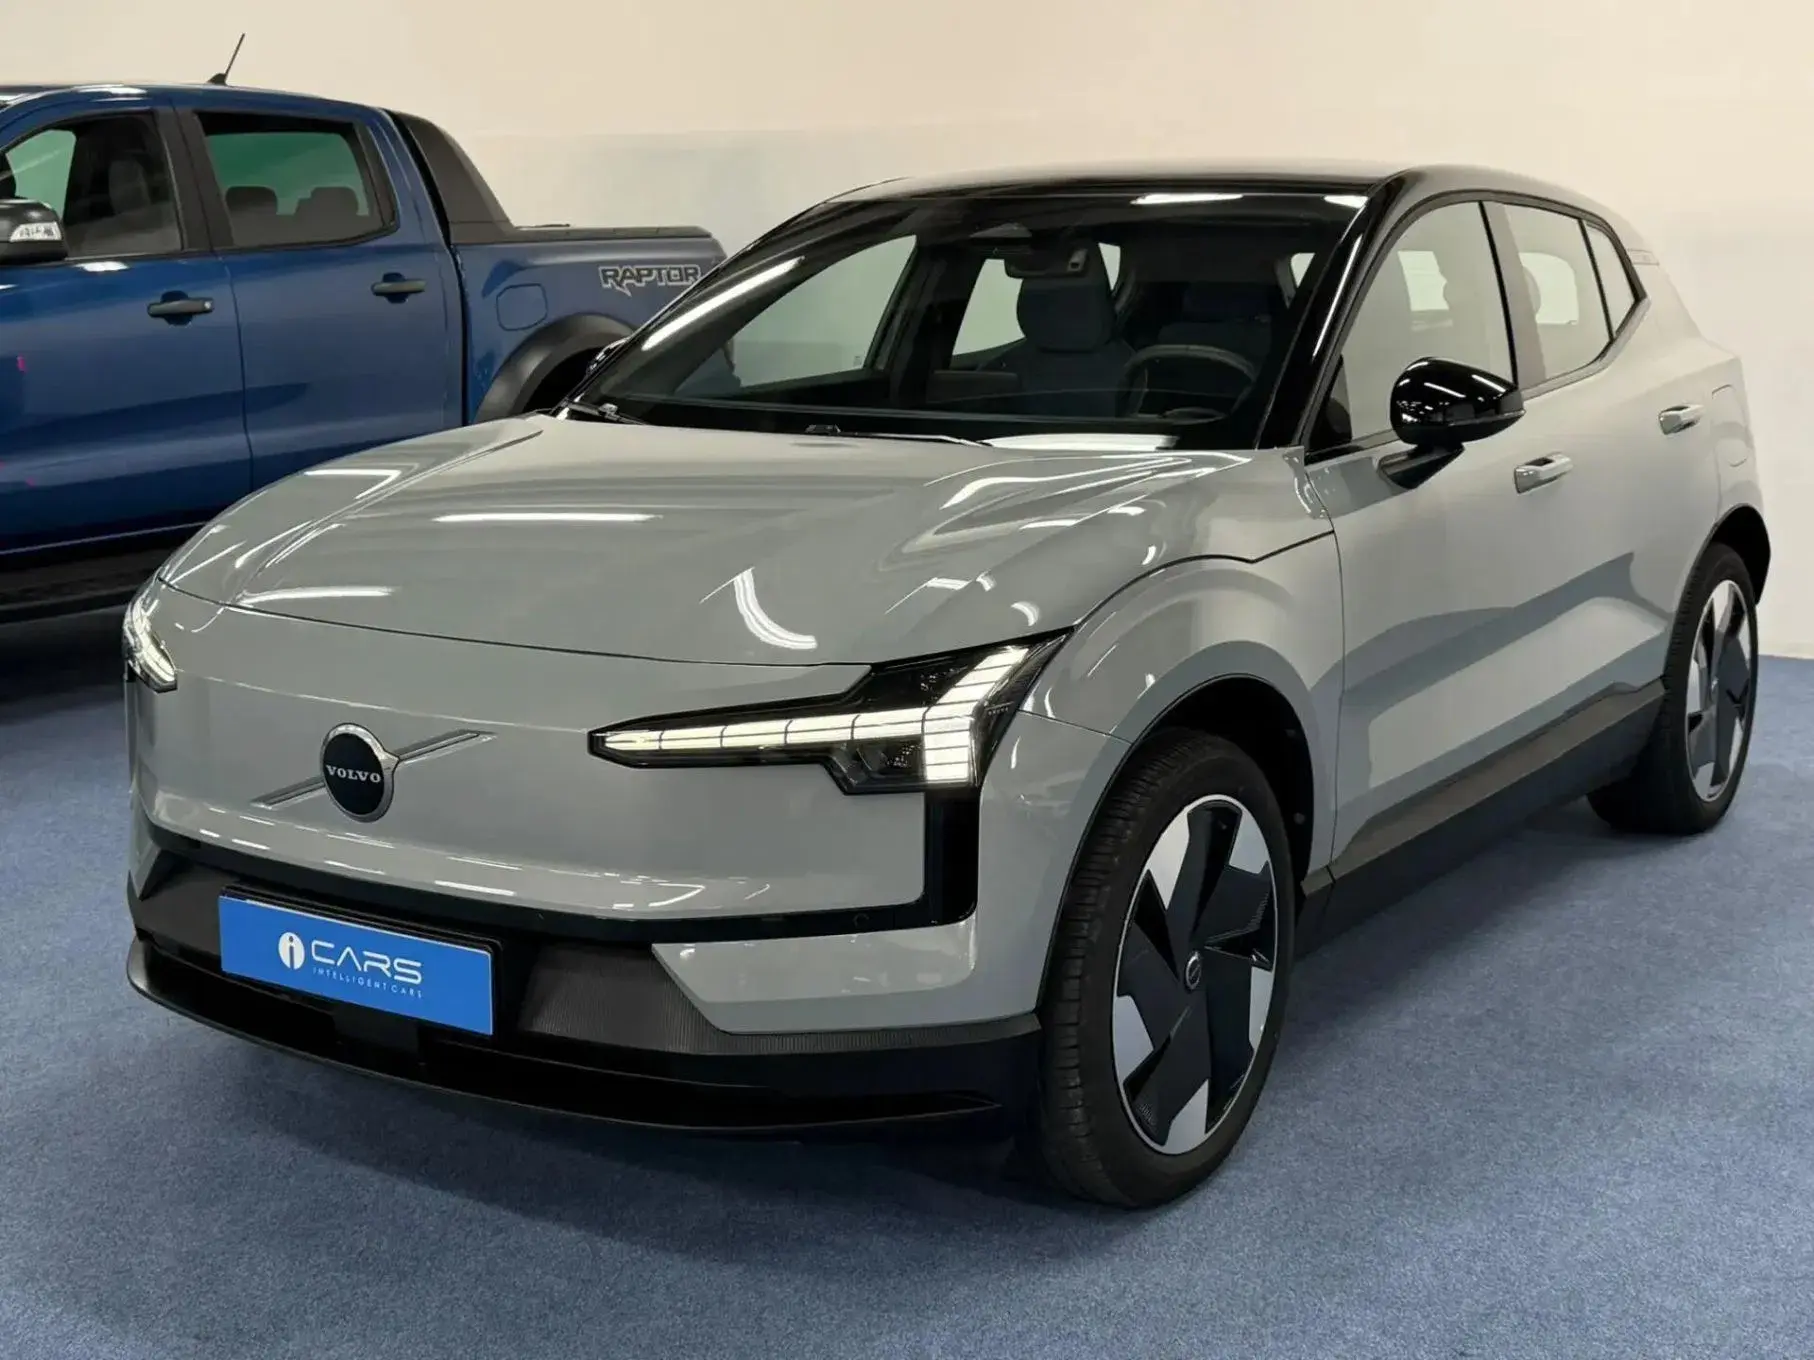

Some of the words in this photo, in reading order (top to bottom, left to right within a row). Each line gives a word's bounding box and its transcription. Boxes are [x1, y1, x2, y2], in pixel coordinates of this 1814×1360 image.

[598, 264, 701, 297] RAPTOR
[325, 764, 381, 783] VOLVO
[311, 940, 422, 985] CARS
